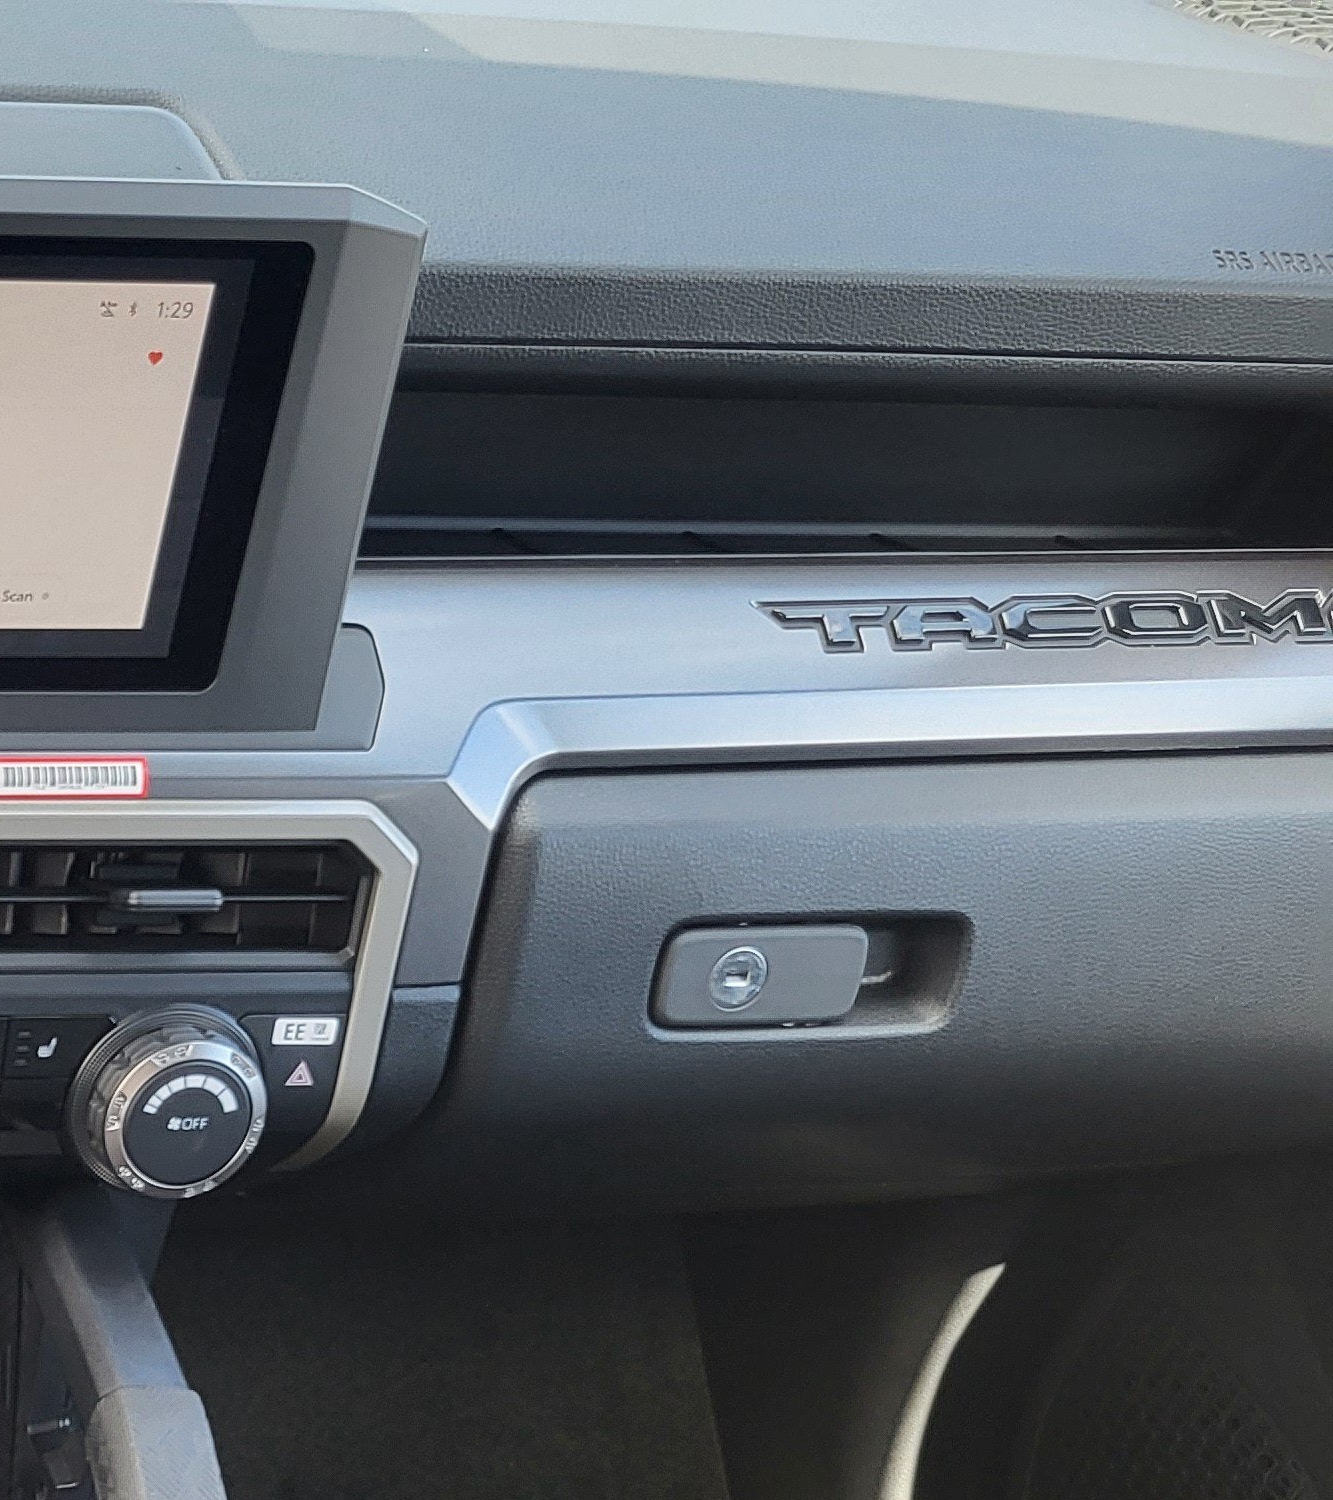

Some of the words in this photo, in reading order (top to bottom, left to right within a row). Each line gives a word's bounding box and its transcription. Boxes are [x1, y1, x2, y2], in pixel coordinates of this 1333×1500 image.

[1212, 249, 1254, 271] SRS
[1259, 250, 1333, 275] AIRBA
[156, 301, 194, 319] 1:29
[2, 589, 34, 602] Scan
[749, 588, 1333, 653] TACOM
[283, 1023, 305, 1041] EE
[181, 1117, 209, 1131] OFF
